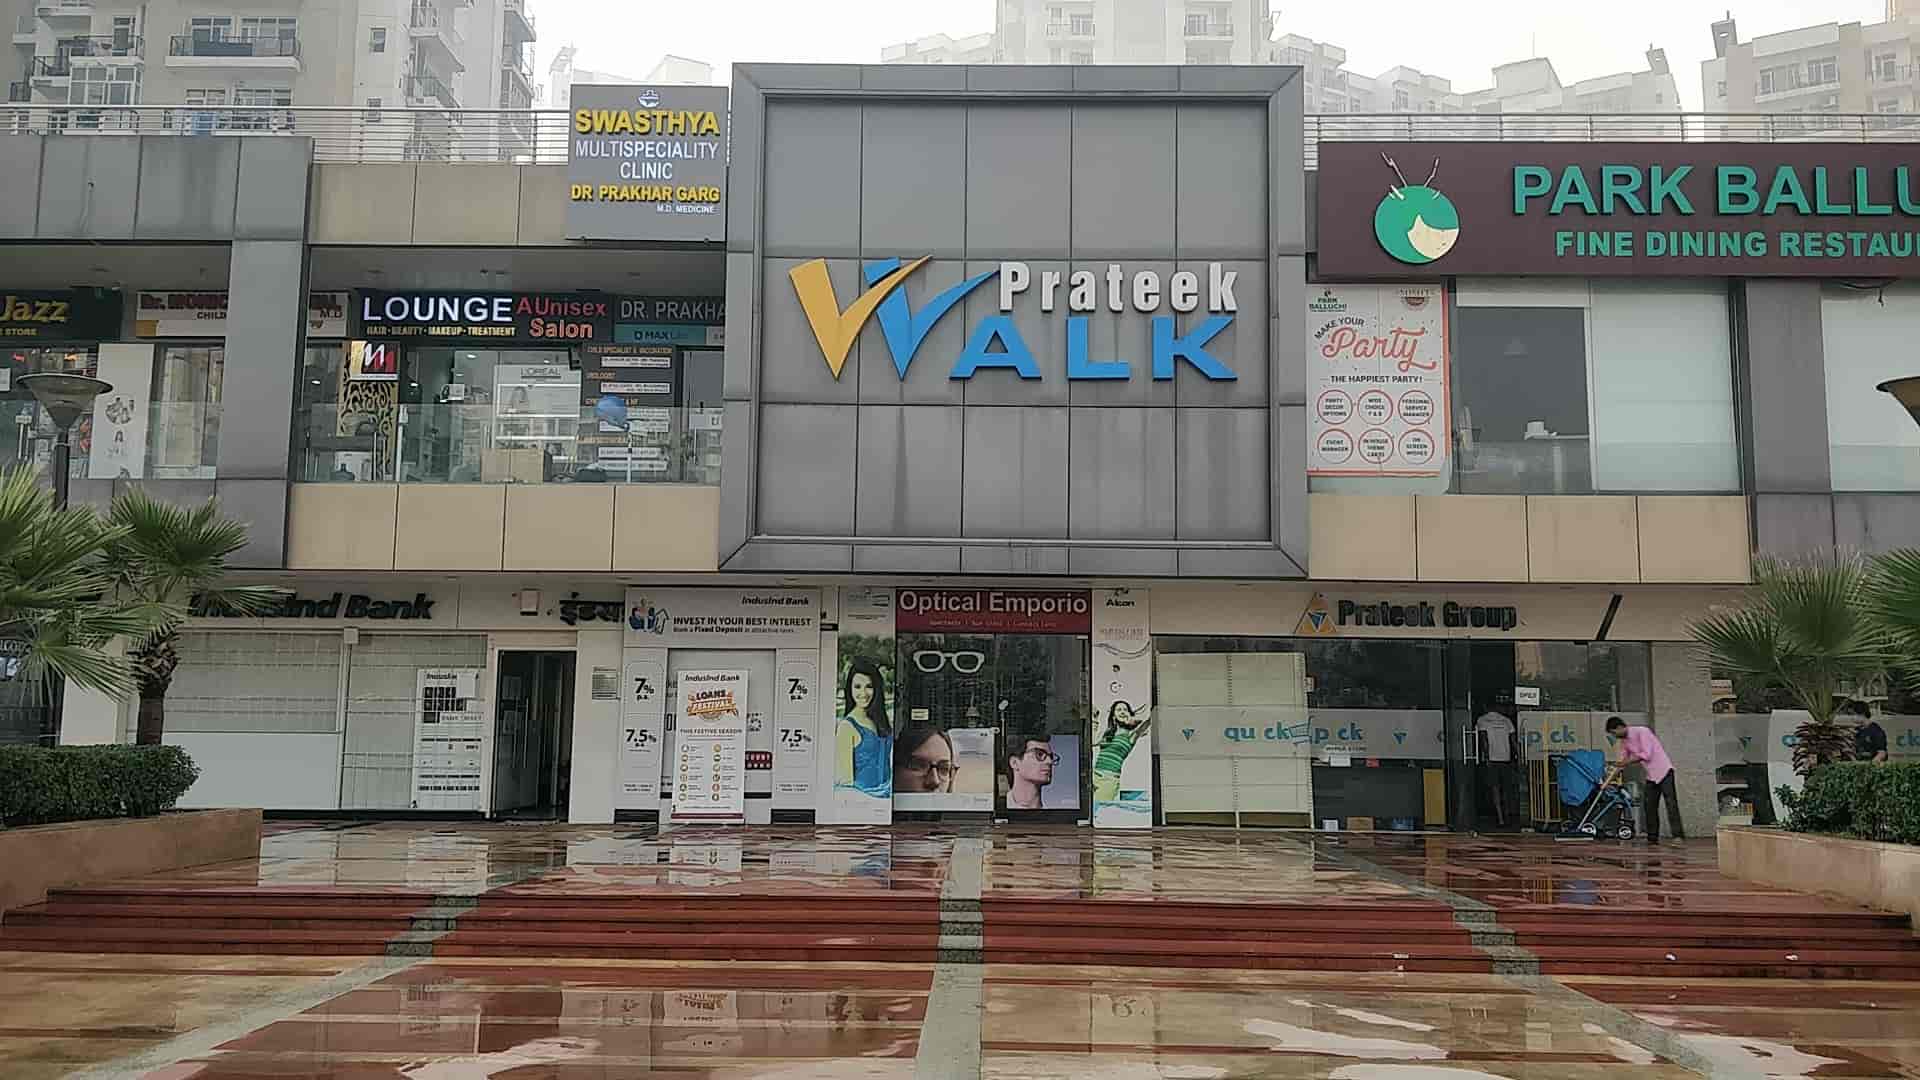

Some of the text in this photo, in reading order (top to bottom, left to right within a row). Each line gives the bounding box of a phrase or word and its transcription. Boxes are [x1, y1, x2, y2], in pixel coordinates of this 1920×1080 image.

[575, 110, 720, 135] SWASTHYA
[575, 140, 719, 159] MULTISPECIALITY
[620, 162, 672, 179] CLINIC
[571, 185, 720, 202] DR PRAKHAR GARG
[1513, 165, 1695, 215] PARK
[676, 205, 715, 213] MEDICINE
[1555, 231, 1920, 257] FINE DINING RESTAU
[1000, 262, 1238, 312] Prateek
[0, 295, 66, 322] Jazz
[196, 311, 227, 320] CHILD
[363, 296, 513, 322] LOUNGE
[428, 326, 463, 336] MAKEUP
[467, 326, 516, 337] TREATMENT
[529, 317, 593, 339] Salon
[1313, 316, 1365, 340] MAKE YOUR
[1321, 326, 1437, 373] Party
[1331, 375, 1346, 383] THE
[1348, 375, 1388, 383] HAPPIEST
[343, 593, 436, 619] Bank
[741, 597, 809, 606] IndusInd Bank
[899, 590, 981, 615] Optical
[988, 592, 1089, 617] Emporio
[1105, 599, 1136, 607] Alcon
[673, 617, 812, 627] INVEST IN YOUR BEST INTEREST
[1338, 600, 1517, 631] Prateek Group
[715, 626, 743, 634] Deposit
[634, 677, 655, 696] 7%
[696, 689, 727, 701] LOANS
[787, 678, 809, 695] 7%
[692, 698, 733, 710] FESTIVAL
[624, 729, 657, 742] 7.5%
[781, 729, 812, 742] 7.5%
[1223, 721, 1363, 745] quck pck
[1520, 723, 1577, 746] pck
